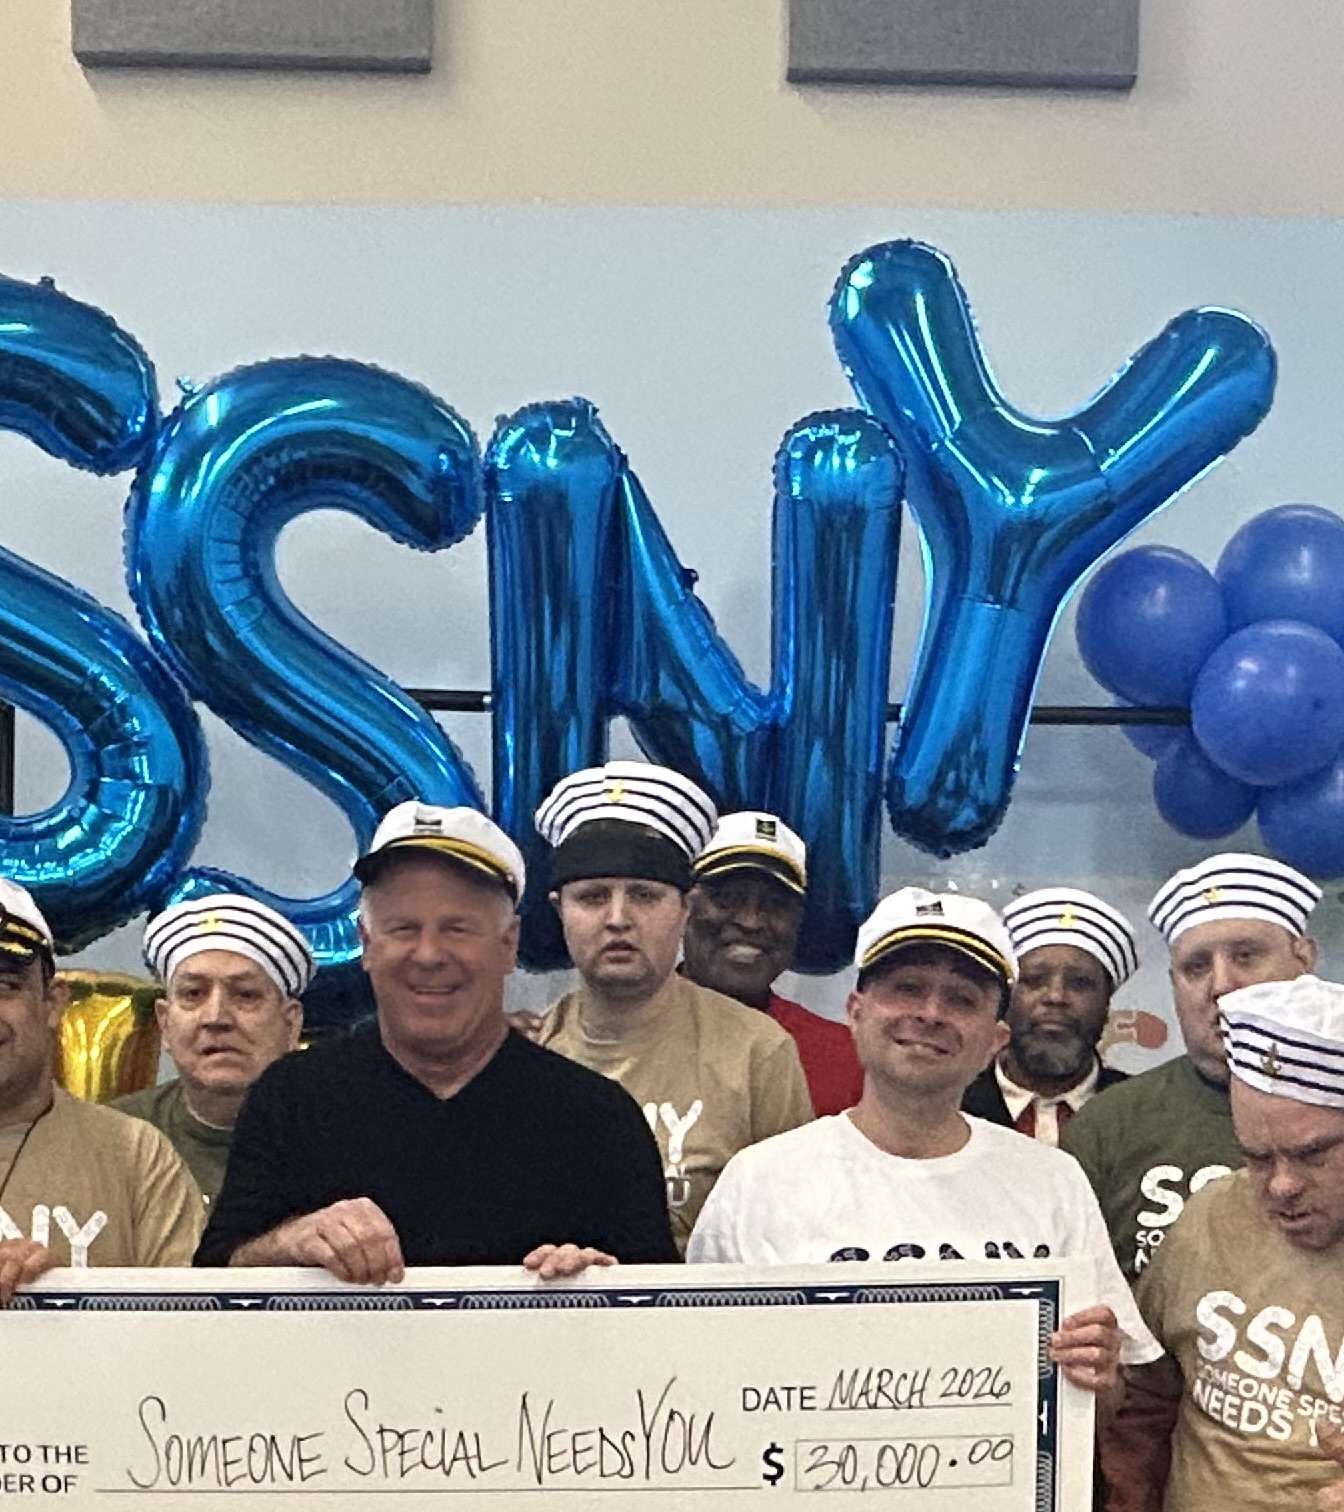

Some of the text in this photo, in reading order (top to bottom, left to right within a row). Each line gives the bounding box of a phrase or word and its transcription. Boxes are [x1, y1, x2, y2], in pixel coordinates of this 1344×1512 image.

[741, 1385, 818, 1413] DATE
[827, 1365, 1012, 1410] MARCH 2026
[1197, 1358, 1294, 1412] MEONE
[1193, 1378, 1294, 1440] NEEDS
[36, 1444, 90, 1465] THE
[127, 1395, 328, 1489] SOMEONE
[761, 1441, 785, 1487] $
[41, 1473, 80, 1494] OF
